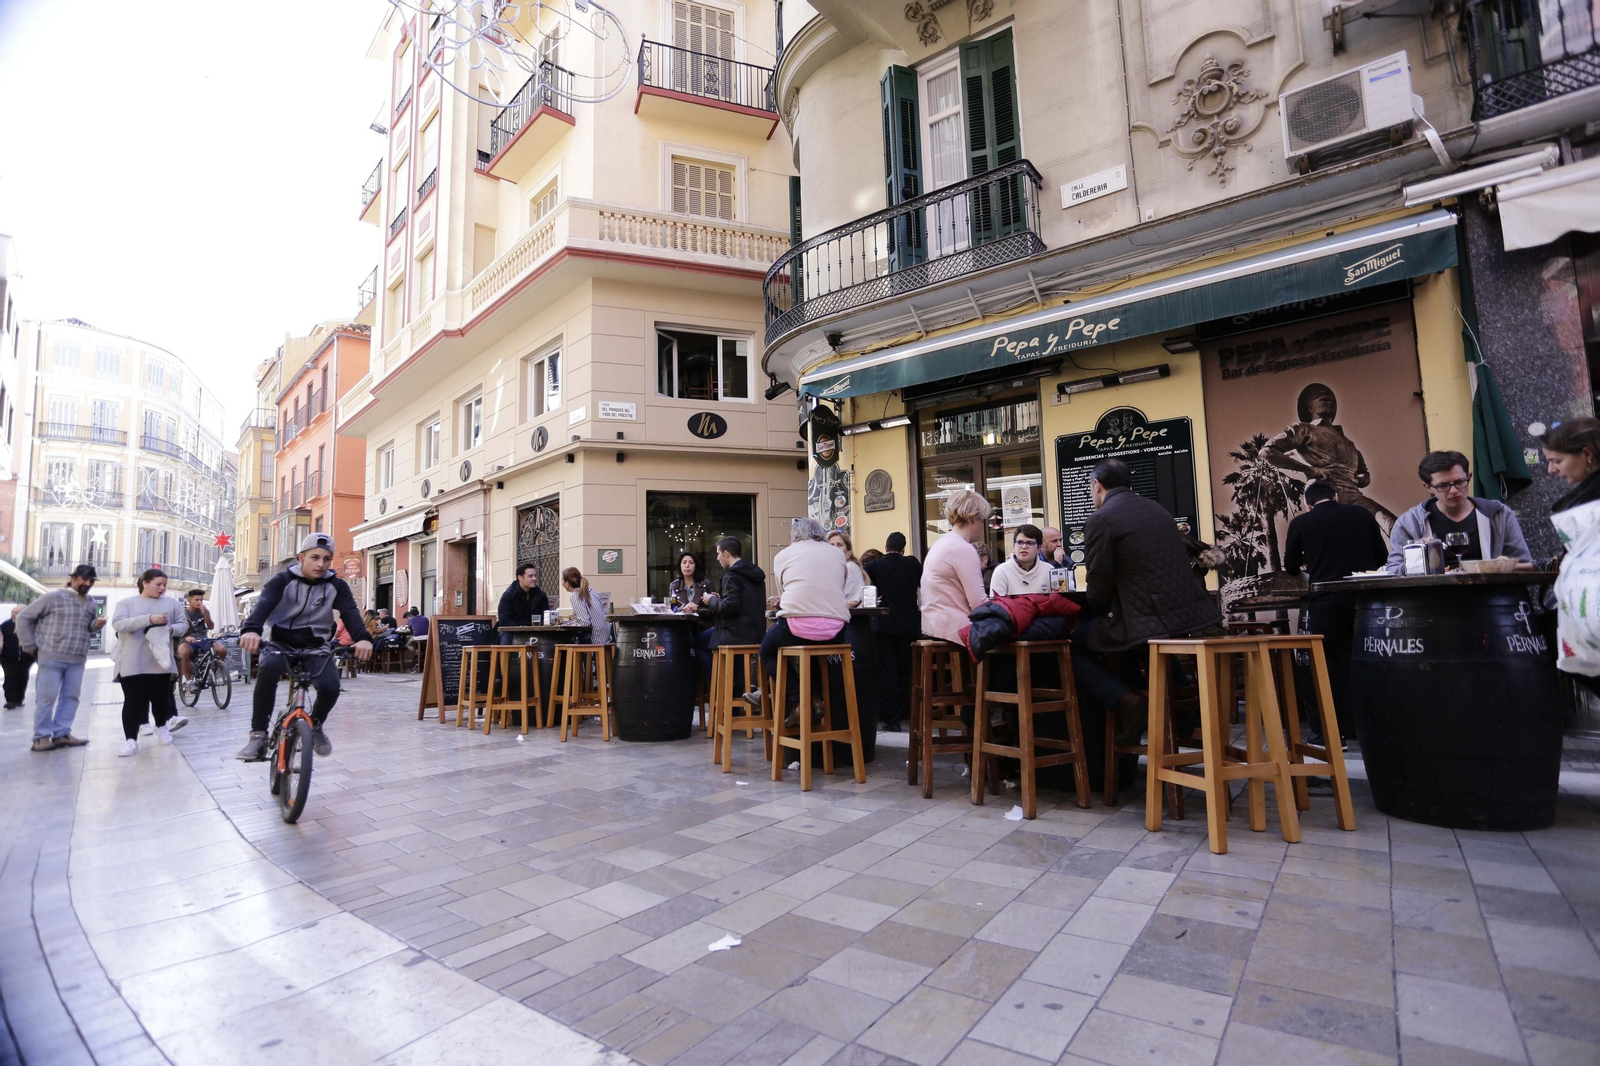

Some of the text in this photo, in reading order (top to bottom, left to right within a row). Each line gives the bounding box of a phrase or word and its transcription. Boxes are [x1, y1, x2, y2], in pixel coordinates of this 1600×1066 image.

[1368, 59, 1401, 73] Panasonic
[1071, 183, 1084, 191] CALLE
[991, 318, 1120, 357] Pepa y Pepe
[1016, 338, 1098, 360] TAPAS FREIDURIA
[1219, 336, 1290, 369] PEPA
[1221, 340, 1392, 380] Bar de Tapas y Freiduría
[1079, 427, 1168, 450] Pepa y Pepe
[1074, 444, 1173, 462] SUGERENCIAS SUGGESTIONS VORSCHLAG
[633, 648, 666, 659] PERNALES
[1364, 638, 1424, 657] PERNALES
